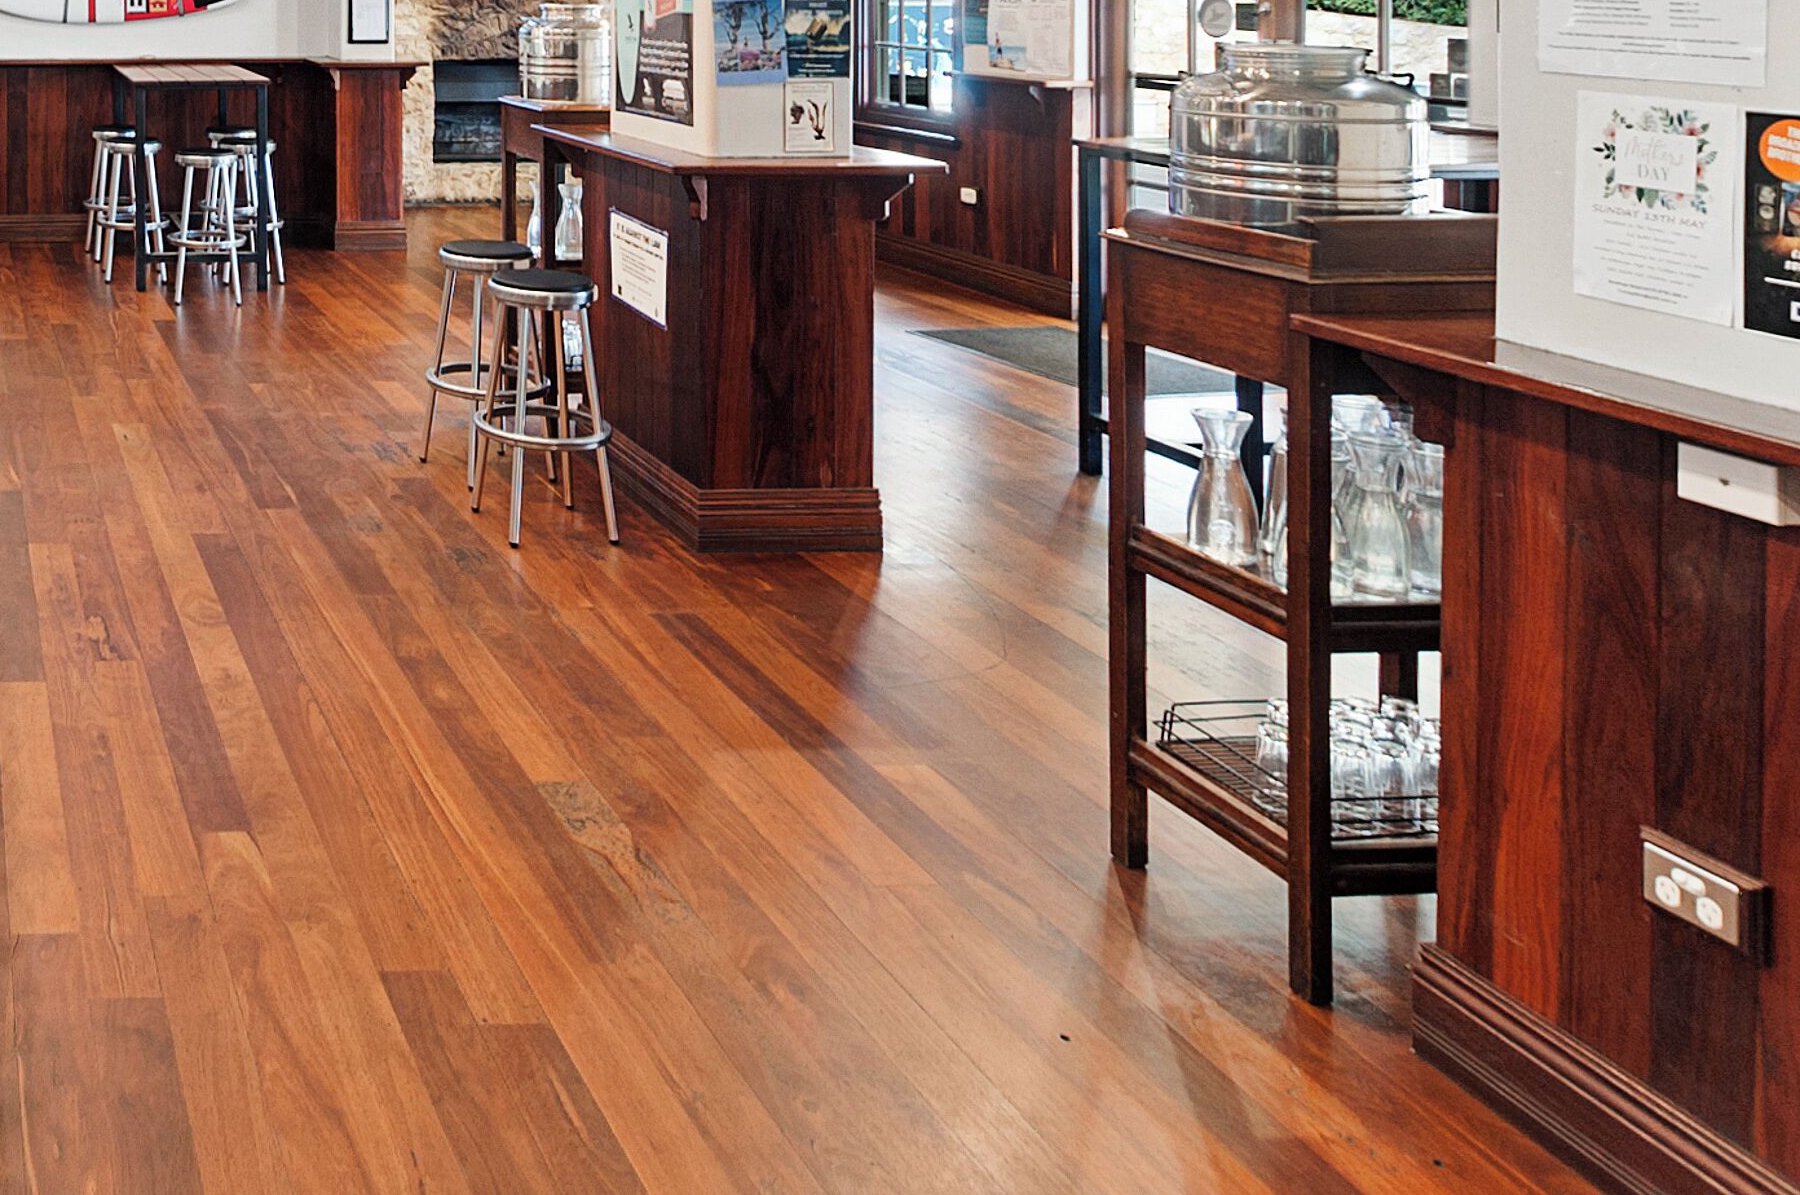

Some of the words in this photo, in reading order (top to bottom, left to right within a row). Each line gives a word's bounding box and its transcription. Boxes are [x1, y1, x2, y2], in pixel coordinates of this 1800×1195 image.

[1638, 164, 1669, 182] DAY
[1592, 203, 1640, 218] SUNDAY
[1680, 218, 1705, 229] MAY
